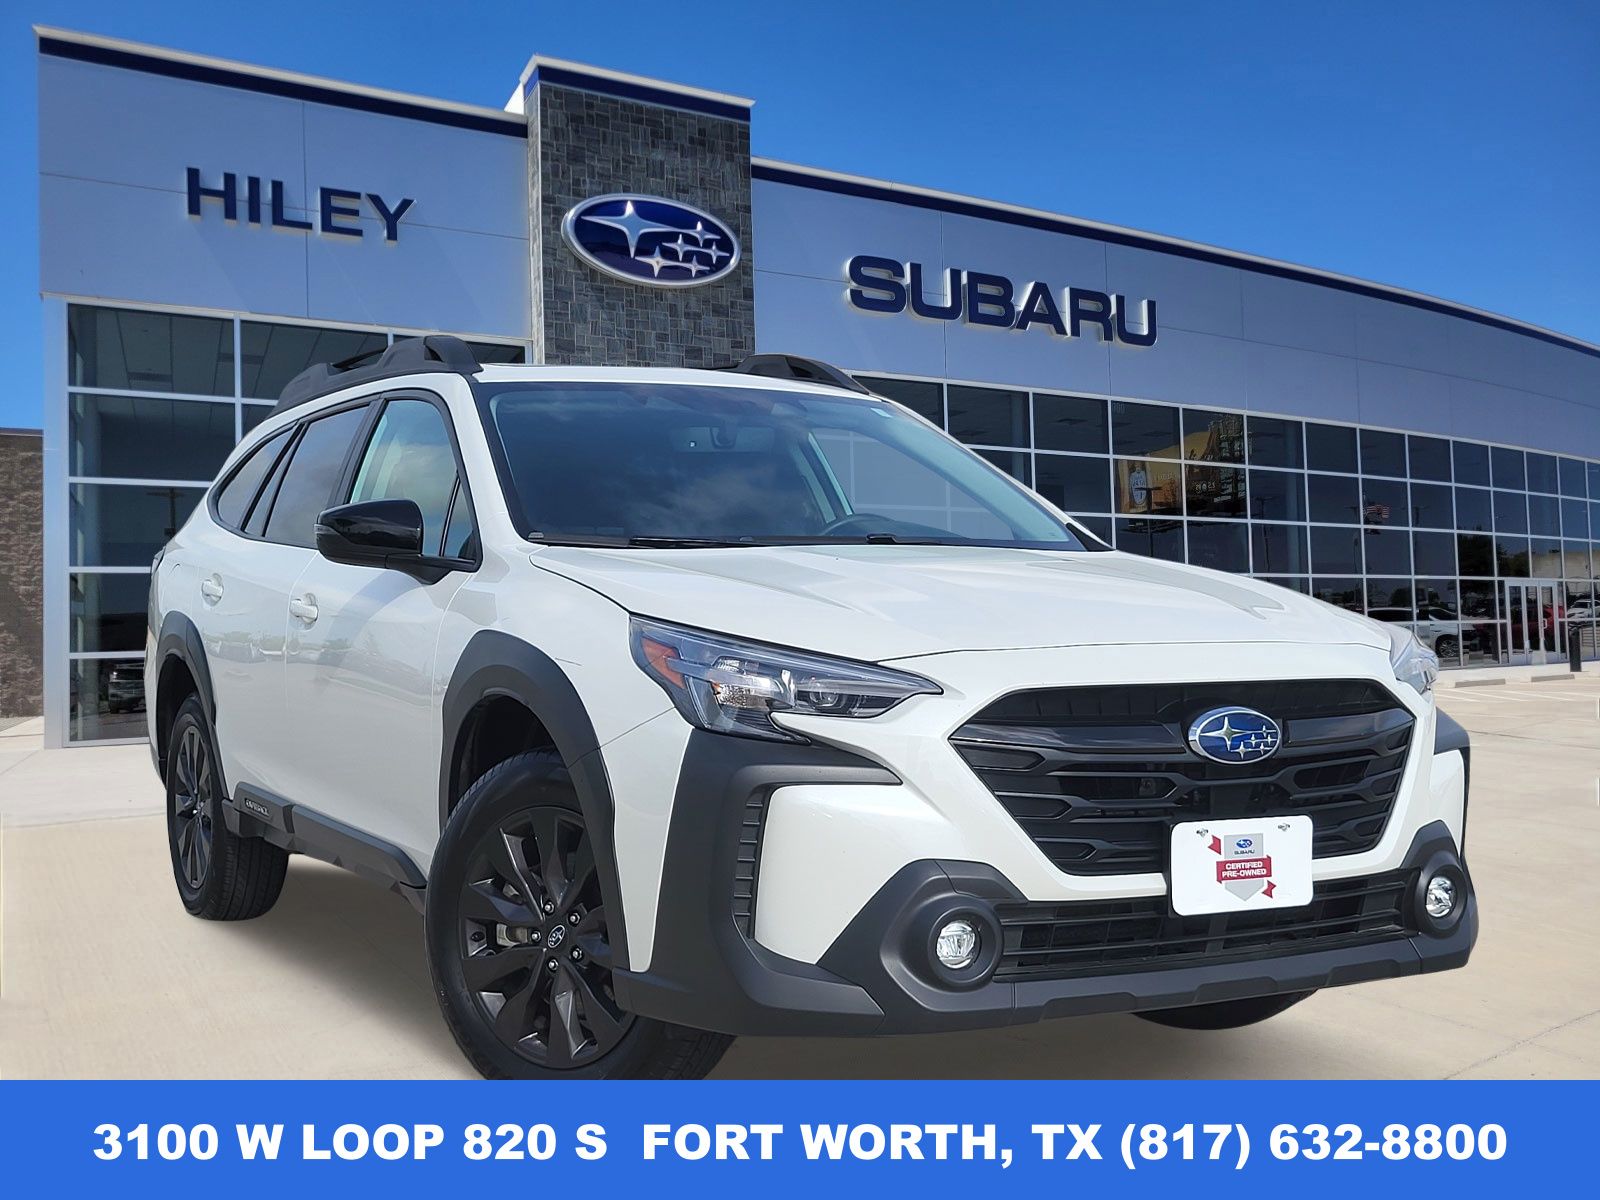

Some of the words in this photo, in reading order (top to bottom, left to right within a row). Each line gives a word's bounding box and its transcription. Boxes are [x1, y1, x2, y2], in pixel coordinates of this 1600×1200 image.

[187, 167, 416, 242] HILEY
[847, 255, 1158, 347] SUBARU
[1222, 869, 1267, 878] PRE-OWNED
[1225, 861, 1263, 870] CERTIFIED
